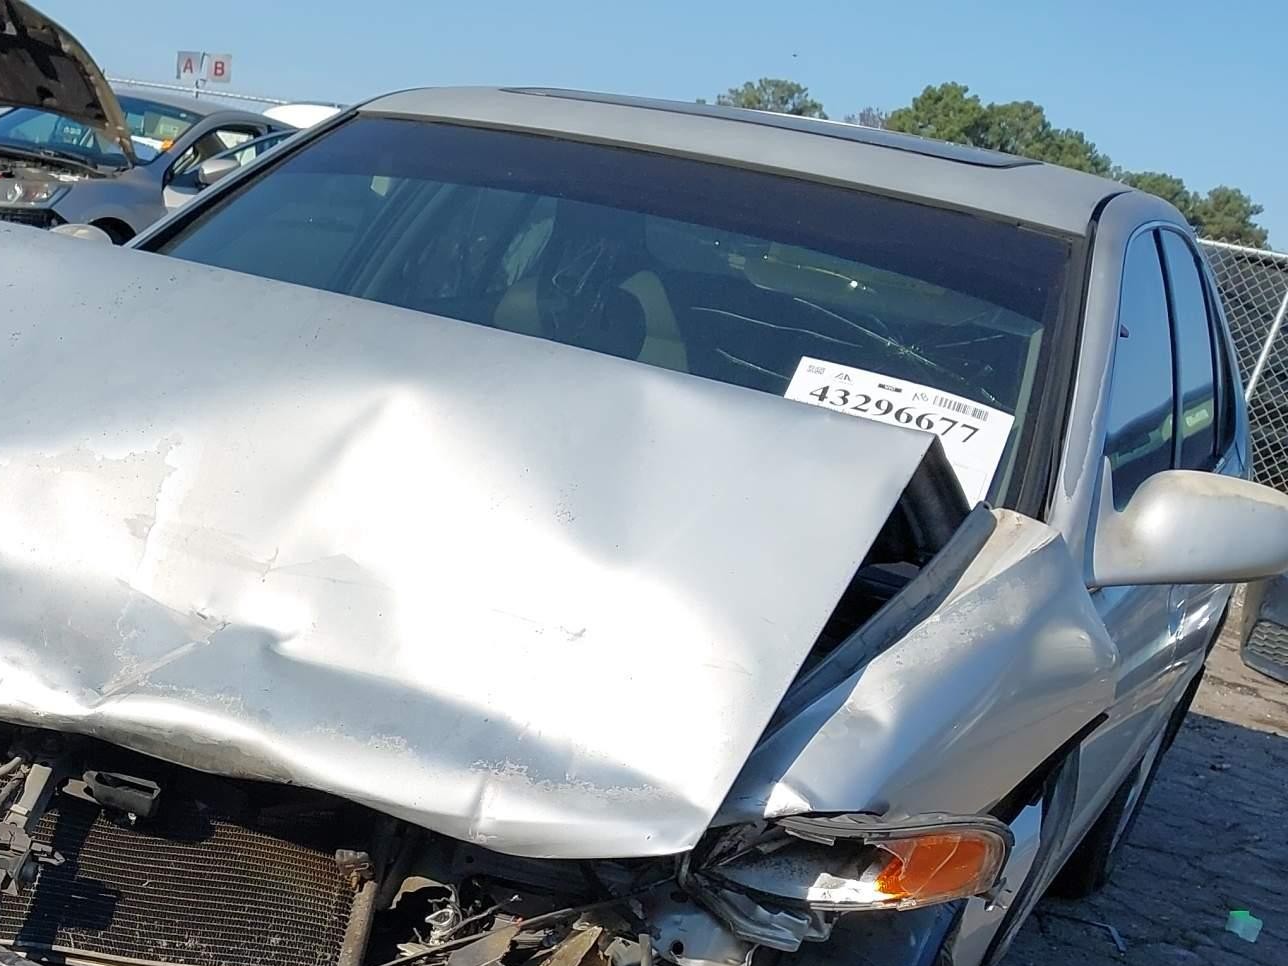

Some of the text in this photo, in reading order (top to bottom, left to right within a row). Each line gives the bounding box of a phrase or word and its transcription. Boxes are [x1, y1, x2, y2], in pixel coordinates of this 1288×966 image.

[183, 58, 193, 73] A
[214, 61, 224, 76] B
[809, 385, 980, 443] 43296677
